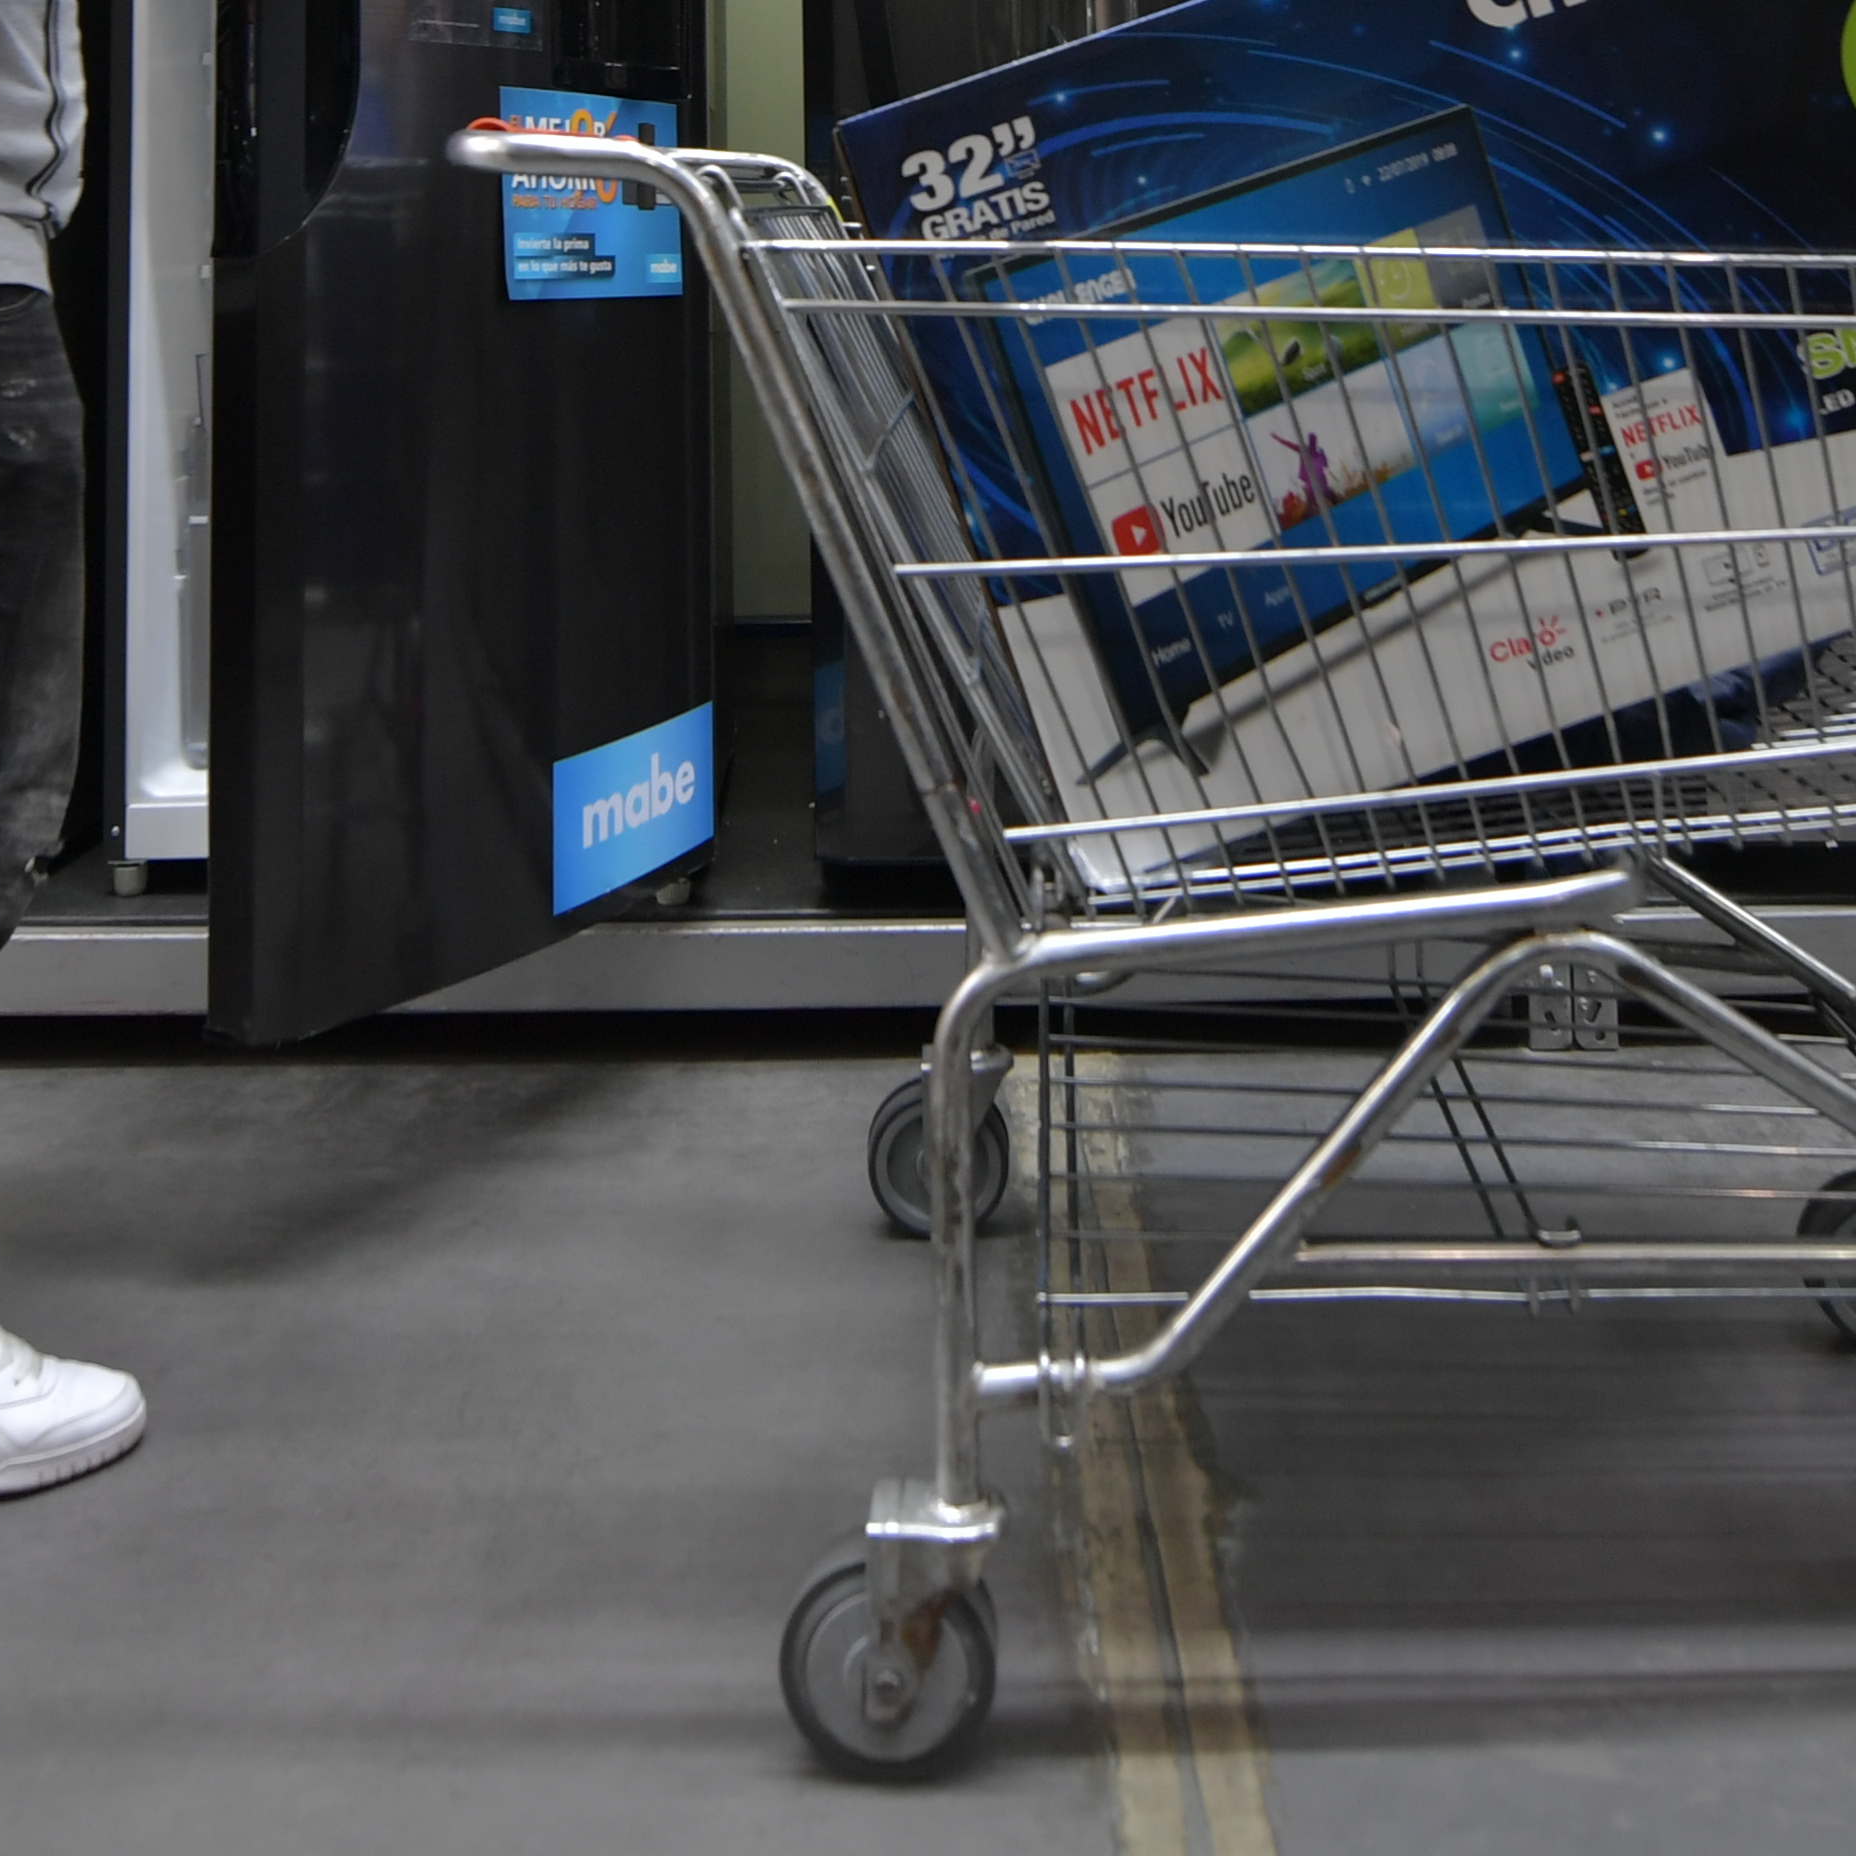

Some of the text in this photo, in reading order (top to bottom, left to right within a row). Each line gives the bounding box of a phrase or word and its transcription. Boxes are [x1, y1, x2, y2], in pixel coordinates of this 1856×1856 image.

[921, 181, 1051, 242] GRATIS
[1011, 210, 1056, 233] Pared
[553, 238, 562, 249] la
[564, 239, 589, 252] prima
[518, 260, 612, 274] en lo que más te gusta
[582, 752, 696, 849] mabe
